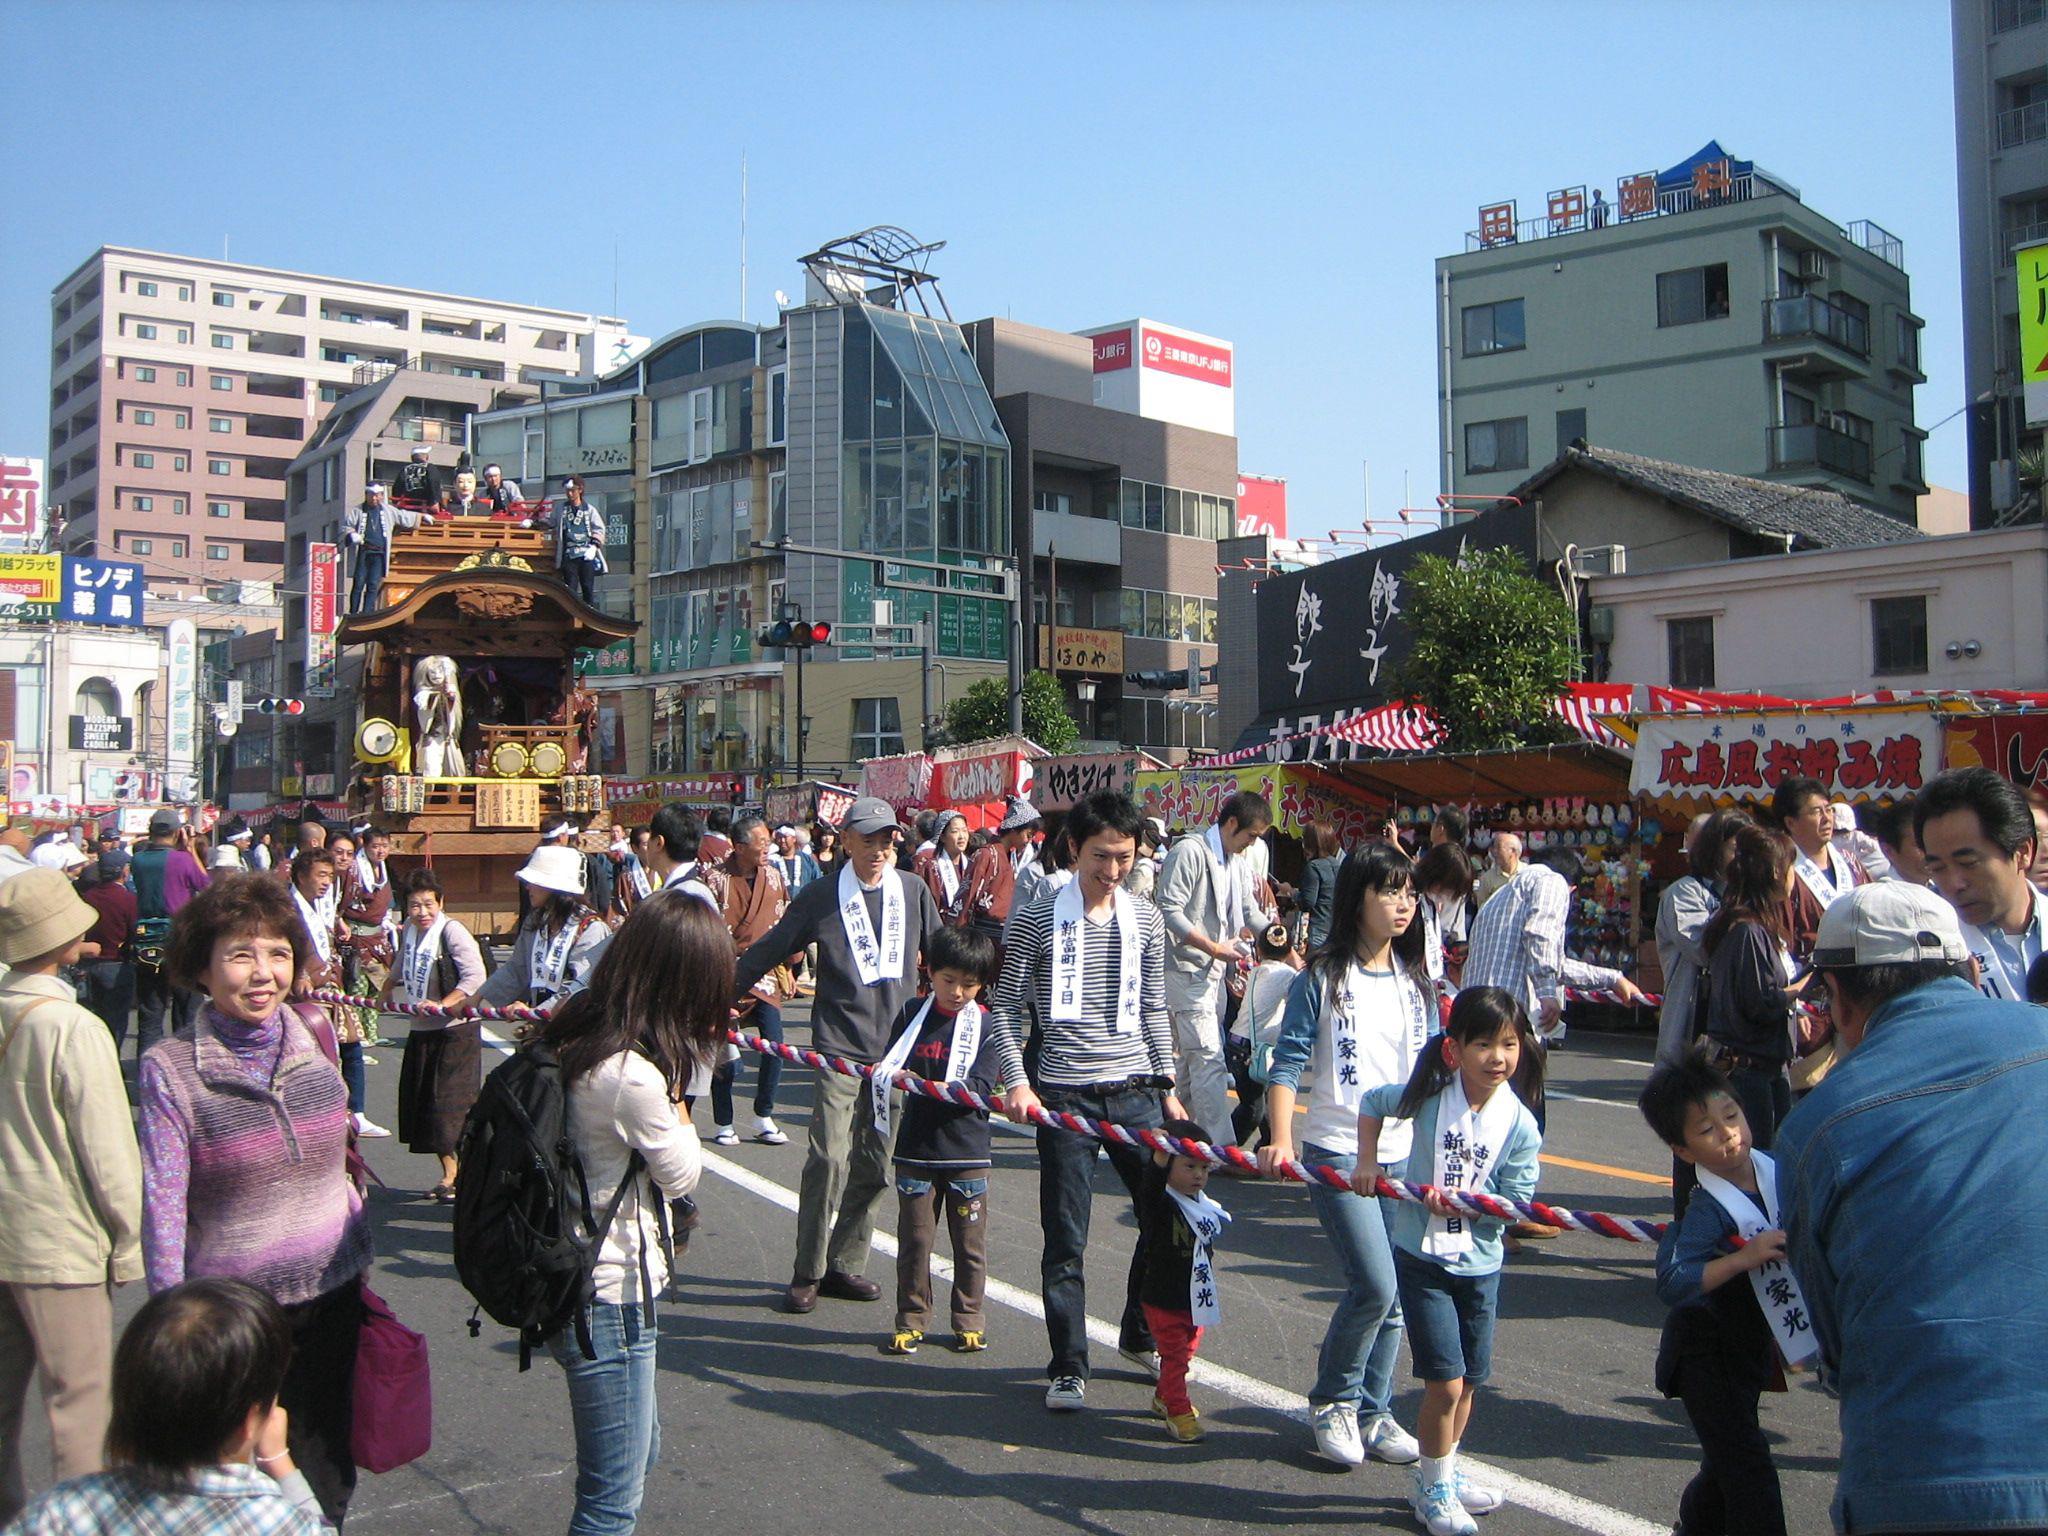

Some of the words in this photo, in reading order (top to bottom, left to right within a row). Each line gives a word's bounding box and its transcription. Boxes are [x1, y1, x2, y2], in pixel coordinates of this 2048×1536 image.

[1480, 157, 1733, 243] 田中歯科
[73, 591, 132, 618] 薬局
[74, 564, 134, 590] ヒノデ
[1057, 648, 1106, 668] ほのや
[1657, 734, 1923, 790] 広島風お好み焼
[1711, 722, 1855, 738] 本場の味
[844, 901, 878, 967] 徳川家光
[888, 894, 900, 964] 新富町一丁目
[1061, 919, 1077, 1005] 新富町一丁目
[1124, 932, 1138, 1017] 徳川家光
[1336, 991, 1358, 1086] 徳川家光
[1444, 1130, 1465, 1234] 新富町目
